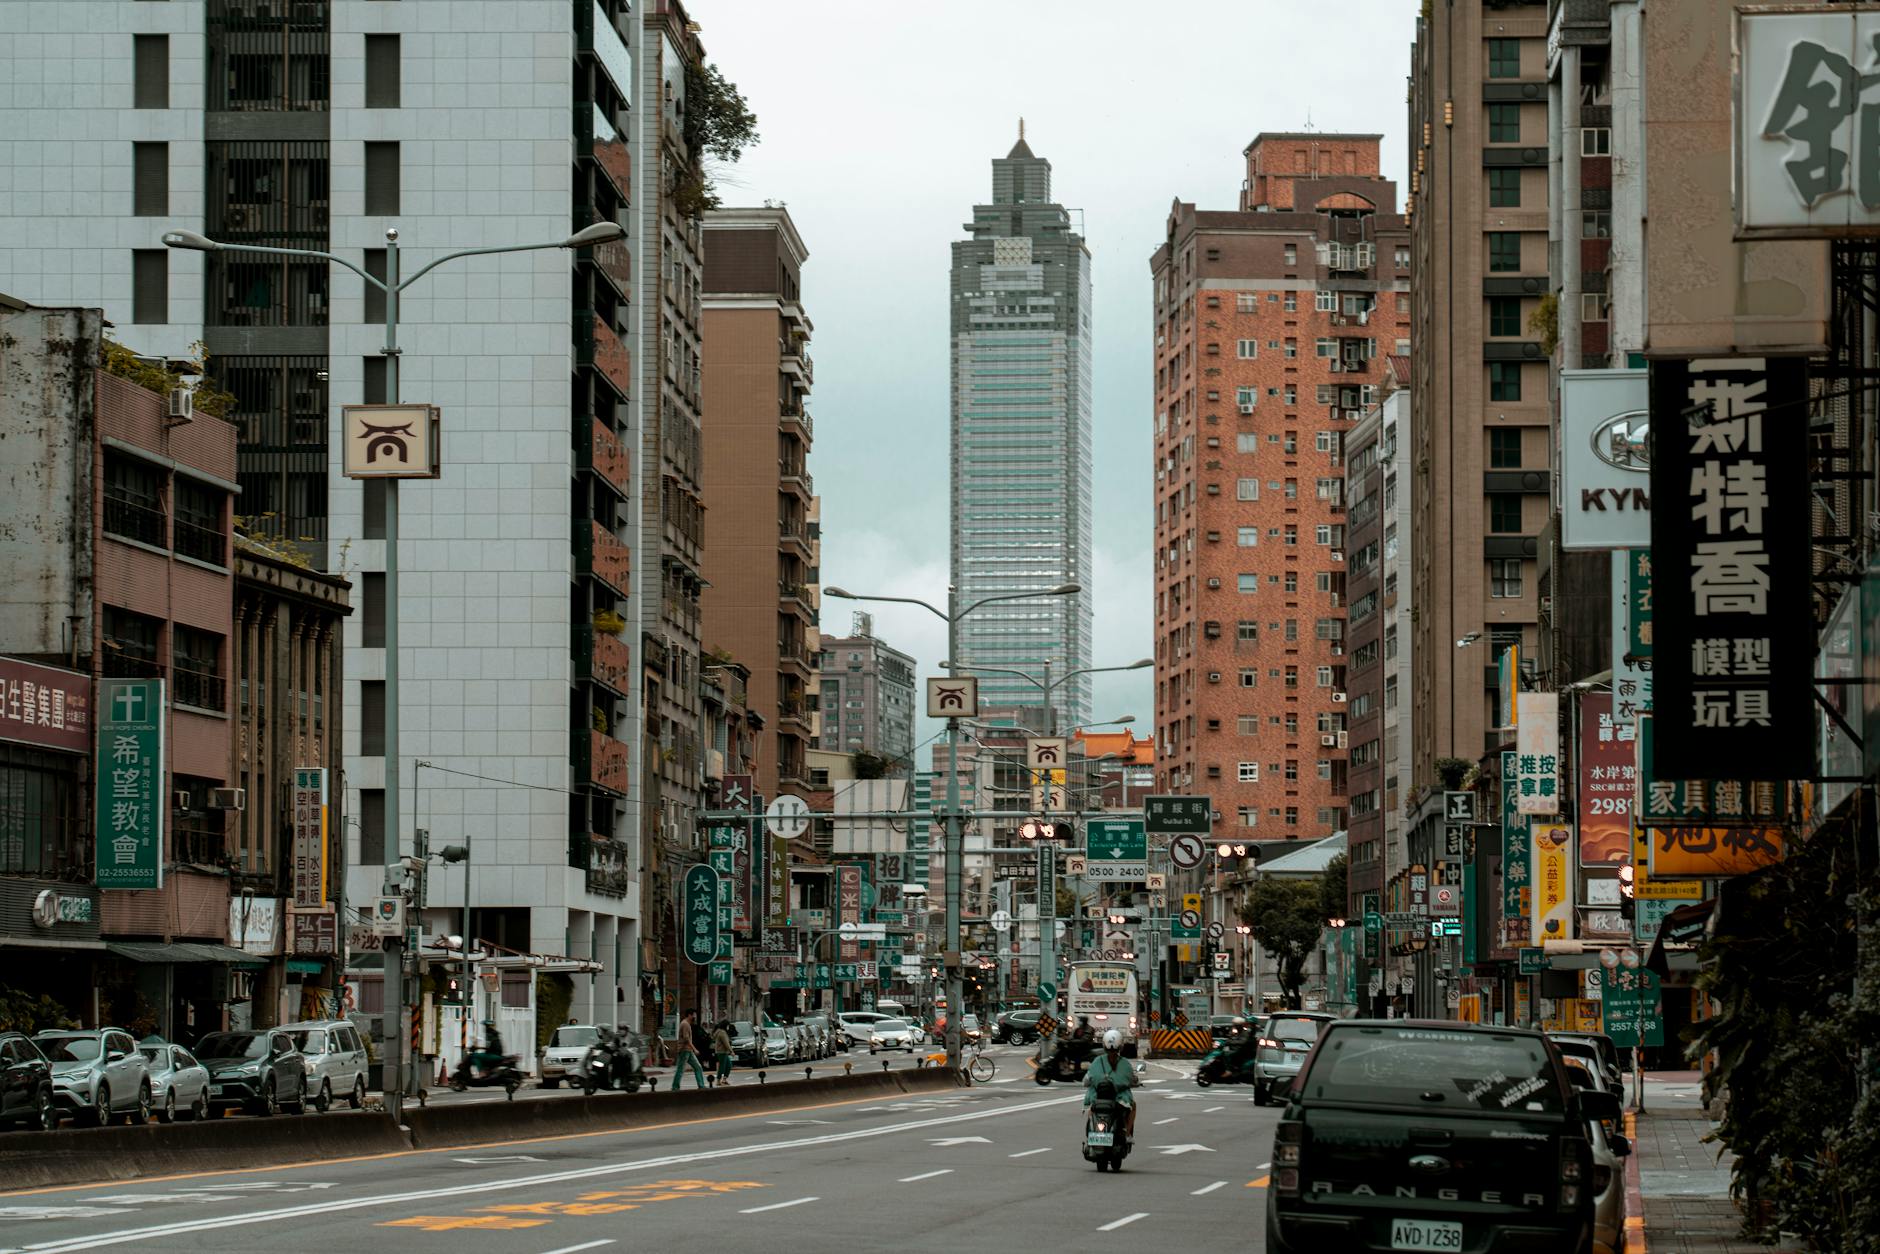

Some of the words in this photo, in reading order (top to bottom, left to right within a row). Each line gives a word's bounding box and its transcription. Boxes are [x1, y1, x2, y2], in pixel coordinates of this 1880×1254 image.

[1687, 359, 1769, 616] 斯特喬
[1692, 638, 1771, 676] 模型
[1619, 679, 1637, 718] 雨衣
[1692, 690, 1772, 728] 玩具
[112, 735, 141, 865] 希望教會
[1590, 798, 1633, 815] 298
[99, 868, 154, 877] 02-25536553
[297, 916, 333, 932] 弘仁
[841, 892, 857, 957] 光陽車
[1312, 1181, 1544, 1206] RANGER
[1394, 1226, 1461, 1248] AVD-1238
